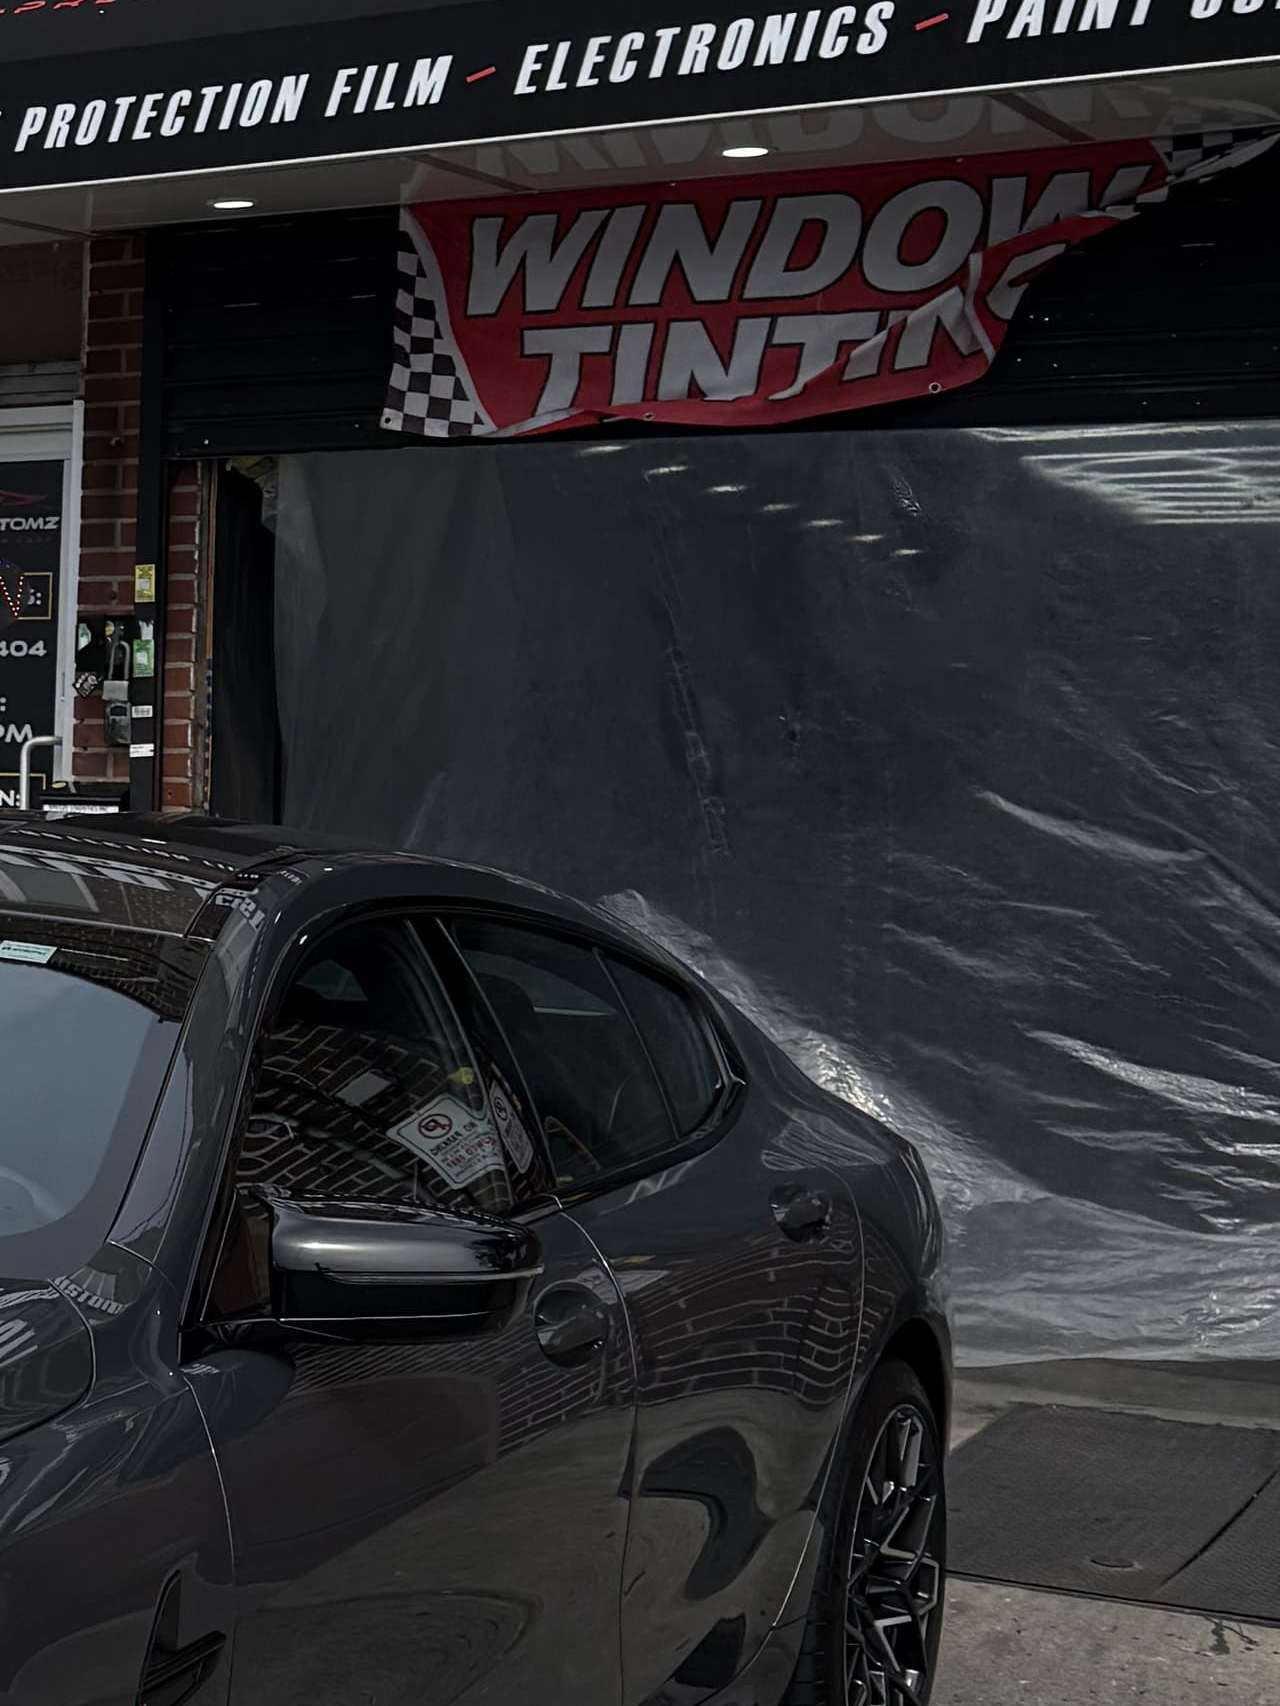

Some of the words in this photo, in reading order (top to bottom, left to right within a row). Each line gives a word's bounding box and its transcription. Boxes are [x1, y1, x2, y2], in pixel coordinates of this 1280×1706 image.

[14, 74, 308, 153] PROTECTION
[324, 57, 453, 119] FILM
[512, 1, 896, 95] ELECTRONICS
